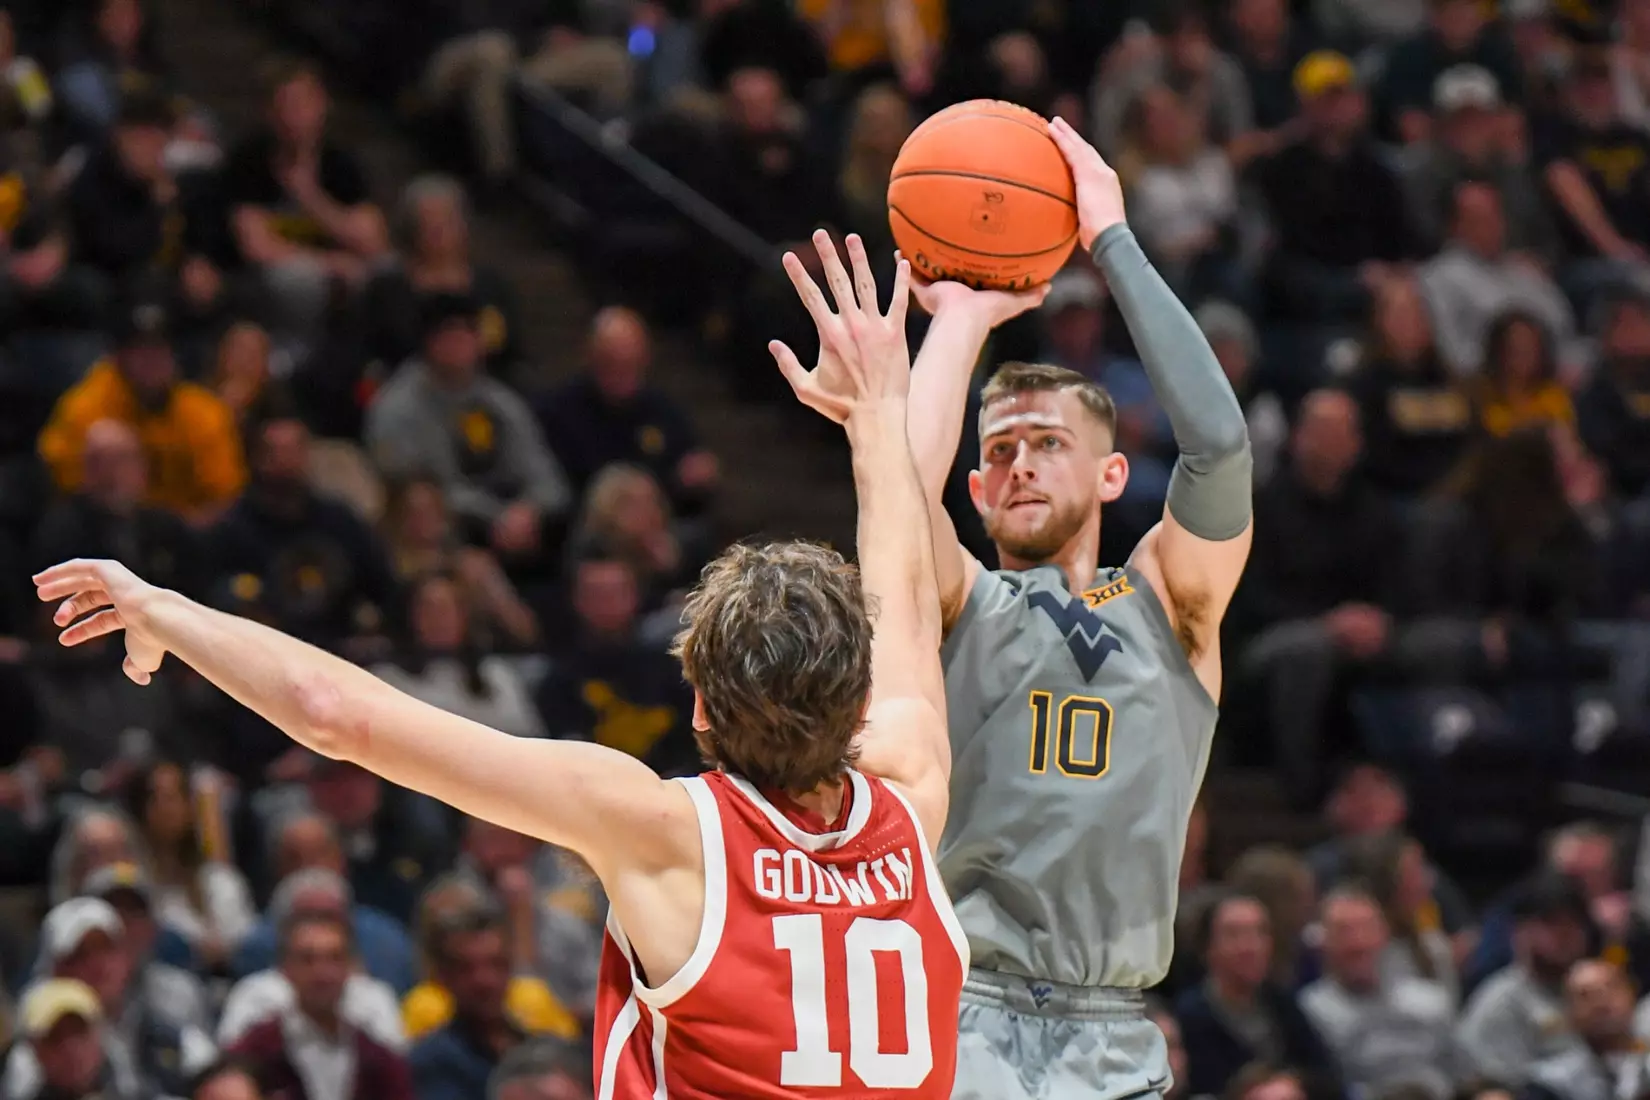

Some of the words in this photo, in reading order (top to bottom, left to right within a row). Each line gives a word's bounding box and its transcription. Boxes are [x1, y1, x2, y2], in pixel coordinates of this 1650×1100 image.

[1086, 580, 1127, 606] XII
[1029, 690, 1114, 780] 10
[753, 848, 913, 906] GODWIN
[772, 913, 933, 1088] 10
